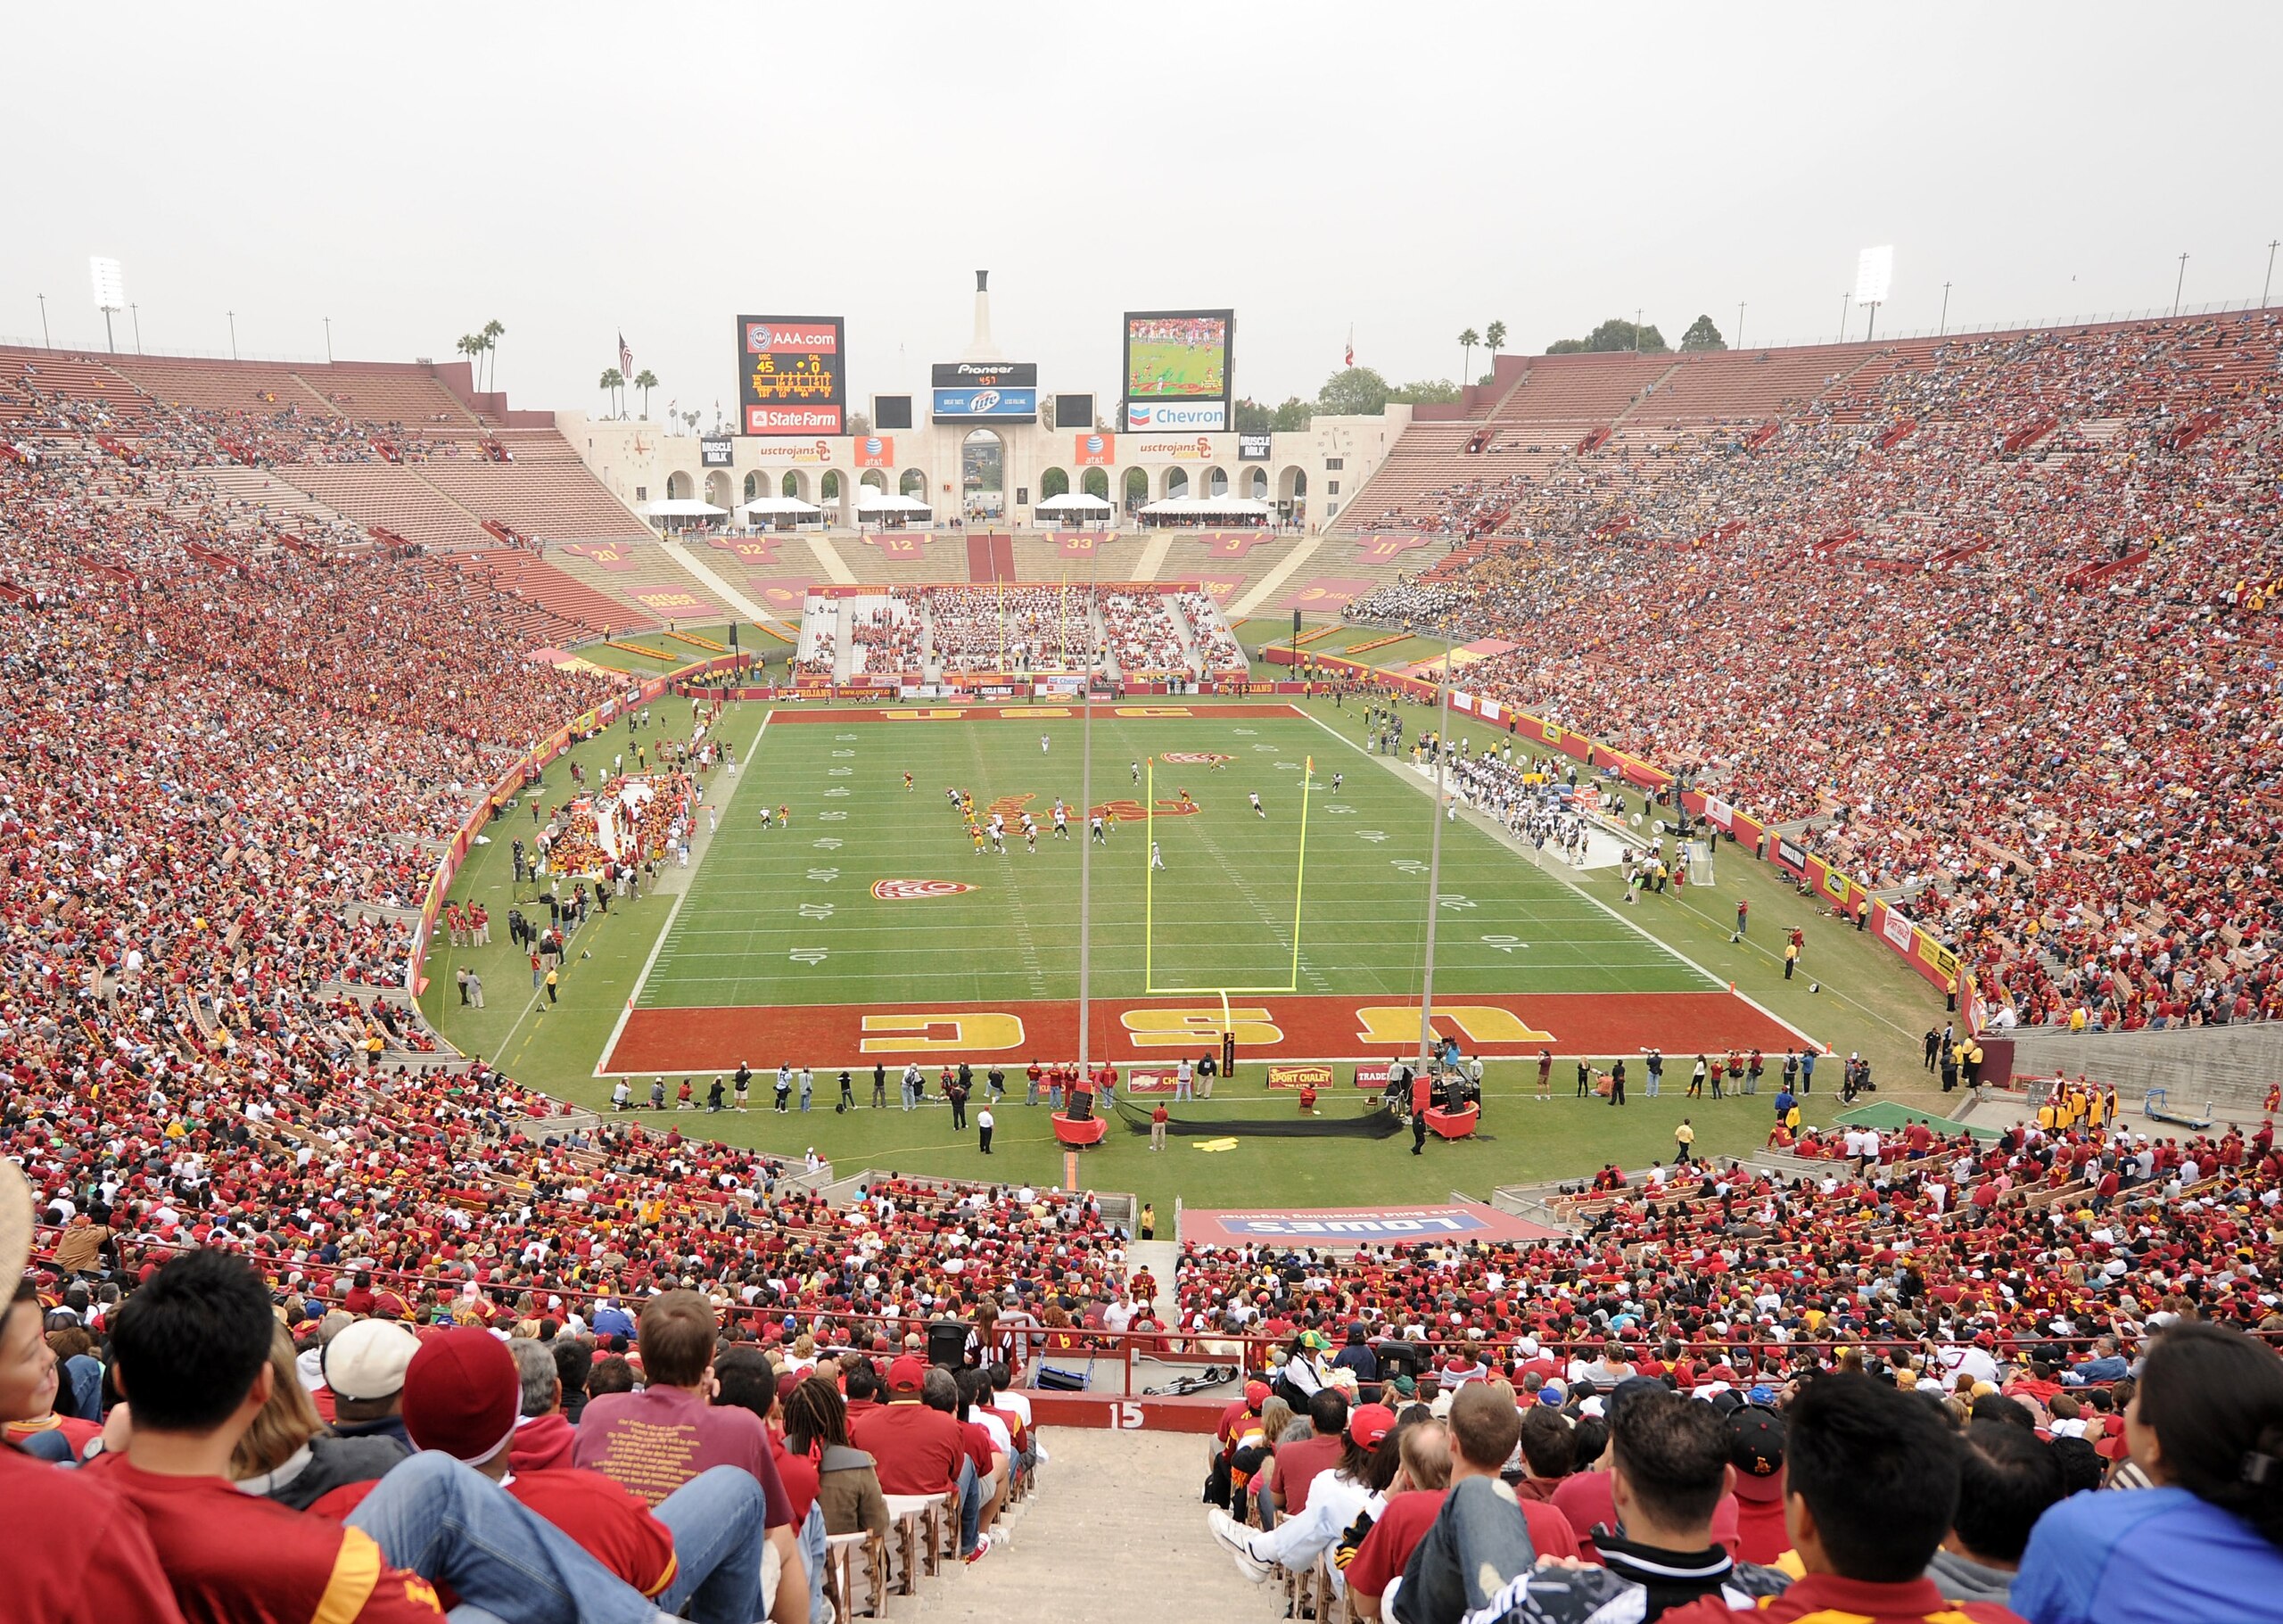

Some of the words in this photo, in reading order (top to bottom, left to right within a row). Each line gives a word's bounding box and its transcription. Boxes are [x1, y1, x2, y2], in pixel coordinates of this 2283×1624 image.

[773, 332, 834, 344] AAA.com
[756, 361, 774, 373] 45
[812, 361, 820, 373] 0
[958, 364, 1013, 375] Pioneer
[1156, 408, 1224, 423] Chevron
[701, 442, 731, 451] MUSCLE
[1240, 435, 1270, 446] MUSCLE
[760, 446, 814, 458] usctrojans
[1140, 442, 1196, 455] usctrojans
[1245, 446, 1265, 457] MILK
[707, 451, 728, 462] MILK
[865, 458, 883, 466] at&t
[1084, 456, 1104, 464] at&t
[737, 544, 765, 555] 32
[890, 540, 913, 551] 12
[1067, 539, 1092, 549] 33
[1225, 540, 1240, 549] 3
[1372, 542, 1398, 555] 11
[591, 549, 620, 562] 20
[638, 594, 691, 602] Office
[648, 599, 700, 607] DEPOT
[1389, 860, 1430, 870] 30
[806, 867, 840, 879] 30
[1436, 894, 1478, 908] 20
[799, 903, 835, 917] 20
[1480, 935, 1529, 949] 10
[788, 947, 828, 961] 10
[1270, 1073, 1298, 1083] SPORT
[1298, 1072, 1331, 1083] CHALET
[2126, 1163, 2136, 1177] 10
[1291, 1212, 1380, 1220] Something
[1247, 1217, 1463, 1233] LOWE'S
[2048, 1292, 2056, 1307] 6
[1109, 1402, 1144, 1429] 15
